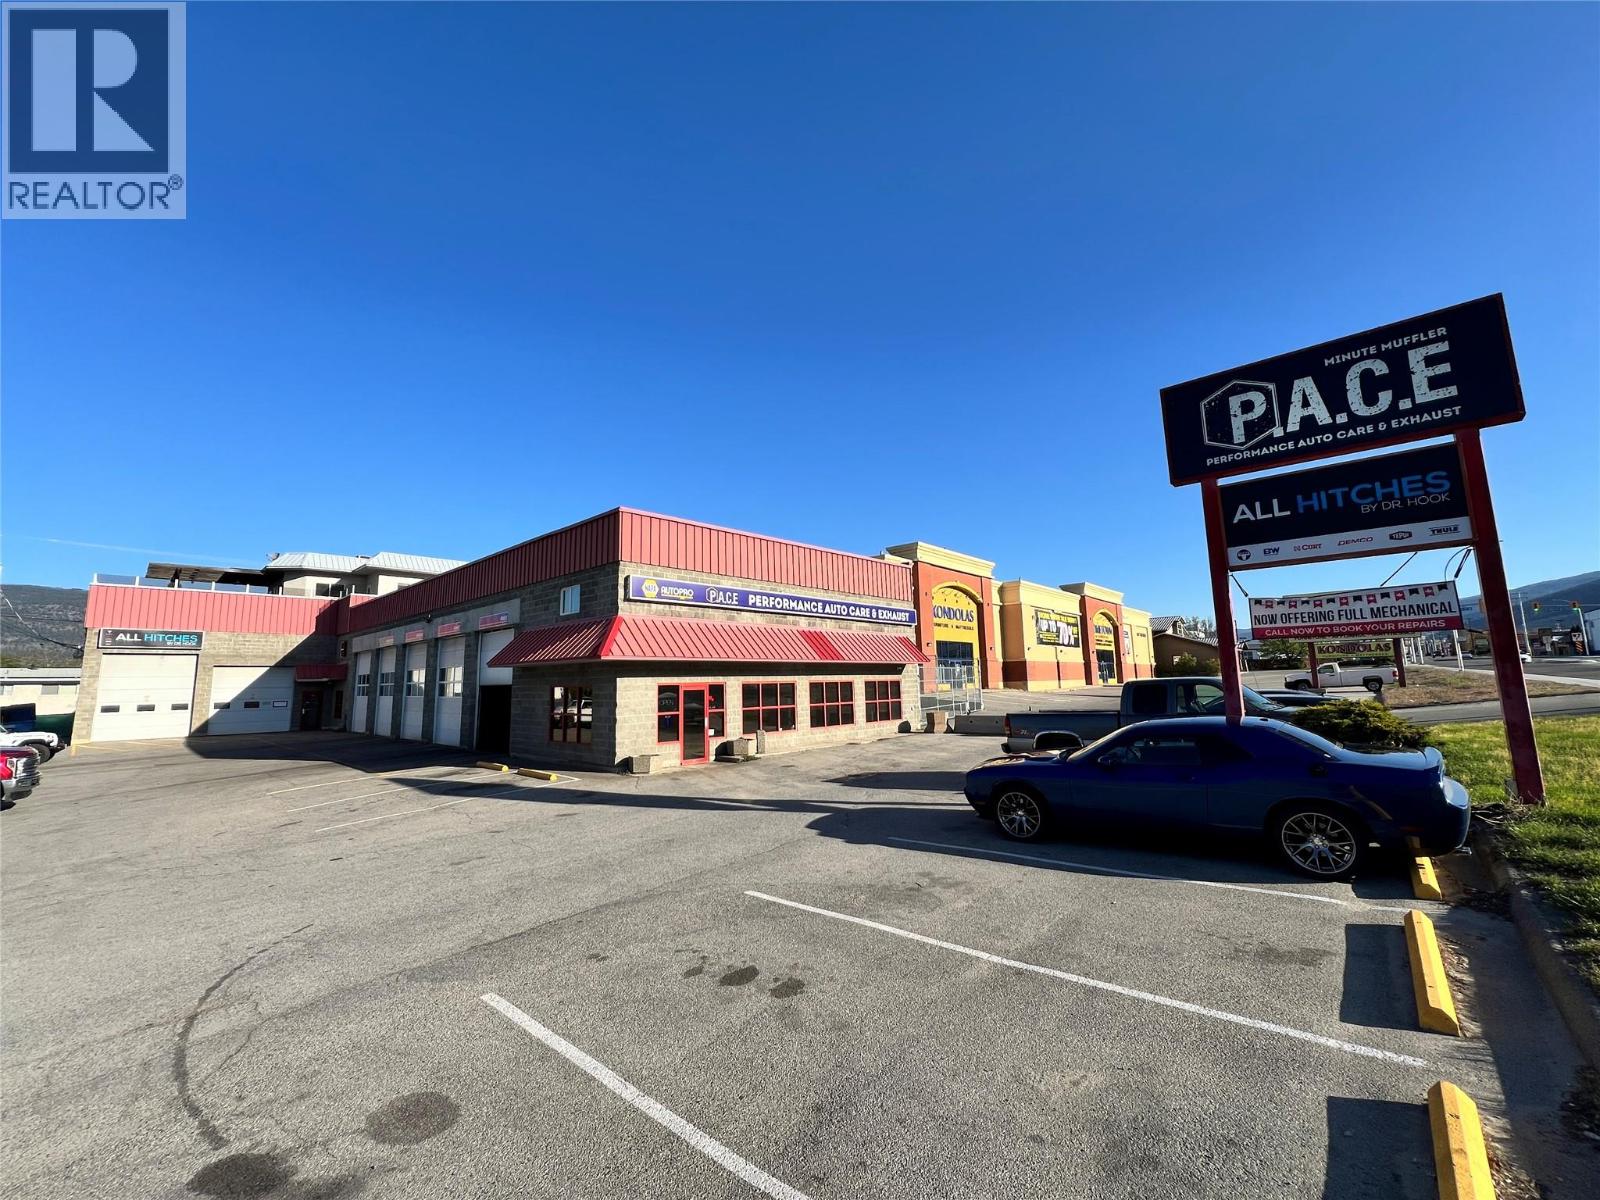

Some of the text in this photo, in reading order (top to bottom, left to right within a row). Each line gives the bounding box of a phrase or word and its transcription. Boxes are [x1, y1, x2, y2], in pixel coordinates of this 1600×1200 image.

[1324, 327, 1447, 366] MINUTE MUFFLER
[1206, 406, 1462, 466] PERFORMANCE AUTO CARE & EXHAUST
[1233, 470, 1450, 523] ALL HITCHES
[1361, 503, 1378, 513] BY
[1407, 492, 1450, 507] HOOK
[661, 586, 694, 597] AUTOPRO
[748, 594, 823, 613] PERFORMANCE
[824, 603, 848, 616] AUTO
[849, 606, 870, 618] CARE
[872, 610, 876, 618] &
[878, 609, 910, 621] EXHAUST
[1254, 601, 1457, 626] NOW OFFERING FULL MECHANICAL
[115, 633, 142, 641] ALL
[144, 633, 198, 643] HITCHES
[1265, 628, 1289, 636] CALL
[1290, 627, 1315, 635] NOW
[1333, 624, 1363, 633] BOOK
[1364, 622, 1396, 632] YOUR
[1398, 619, 1446, 630] REPAIRS
[1317, 642, 1391, 654] KONDOLAS
